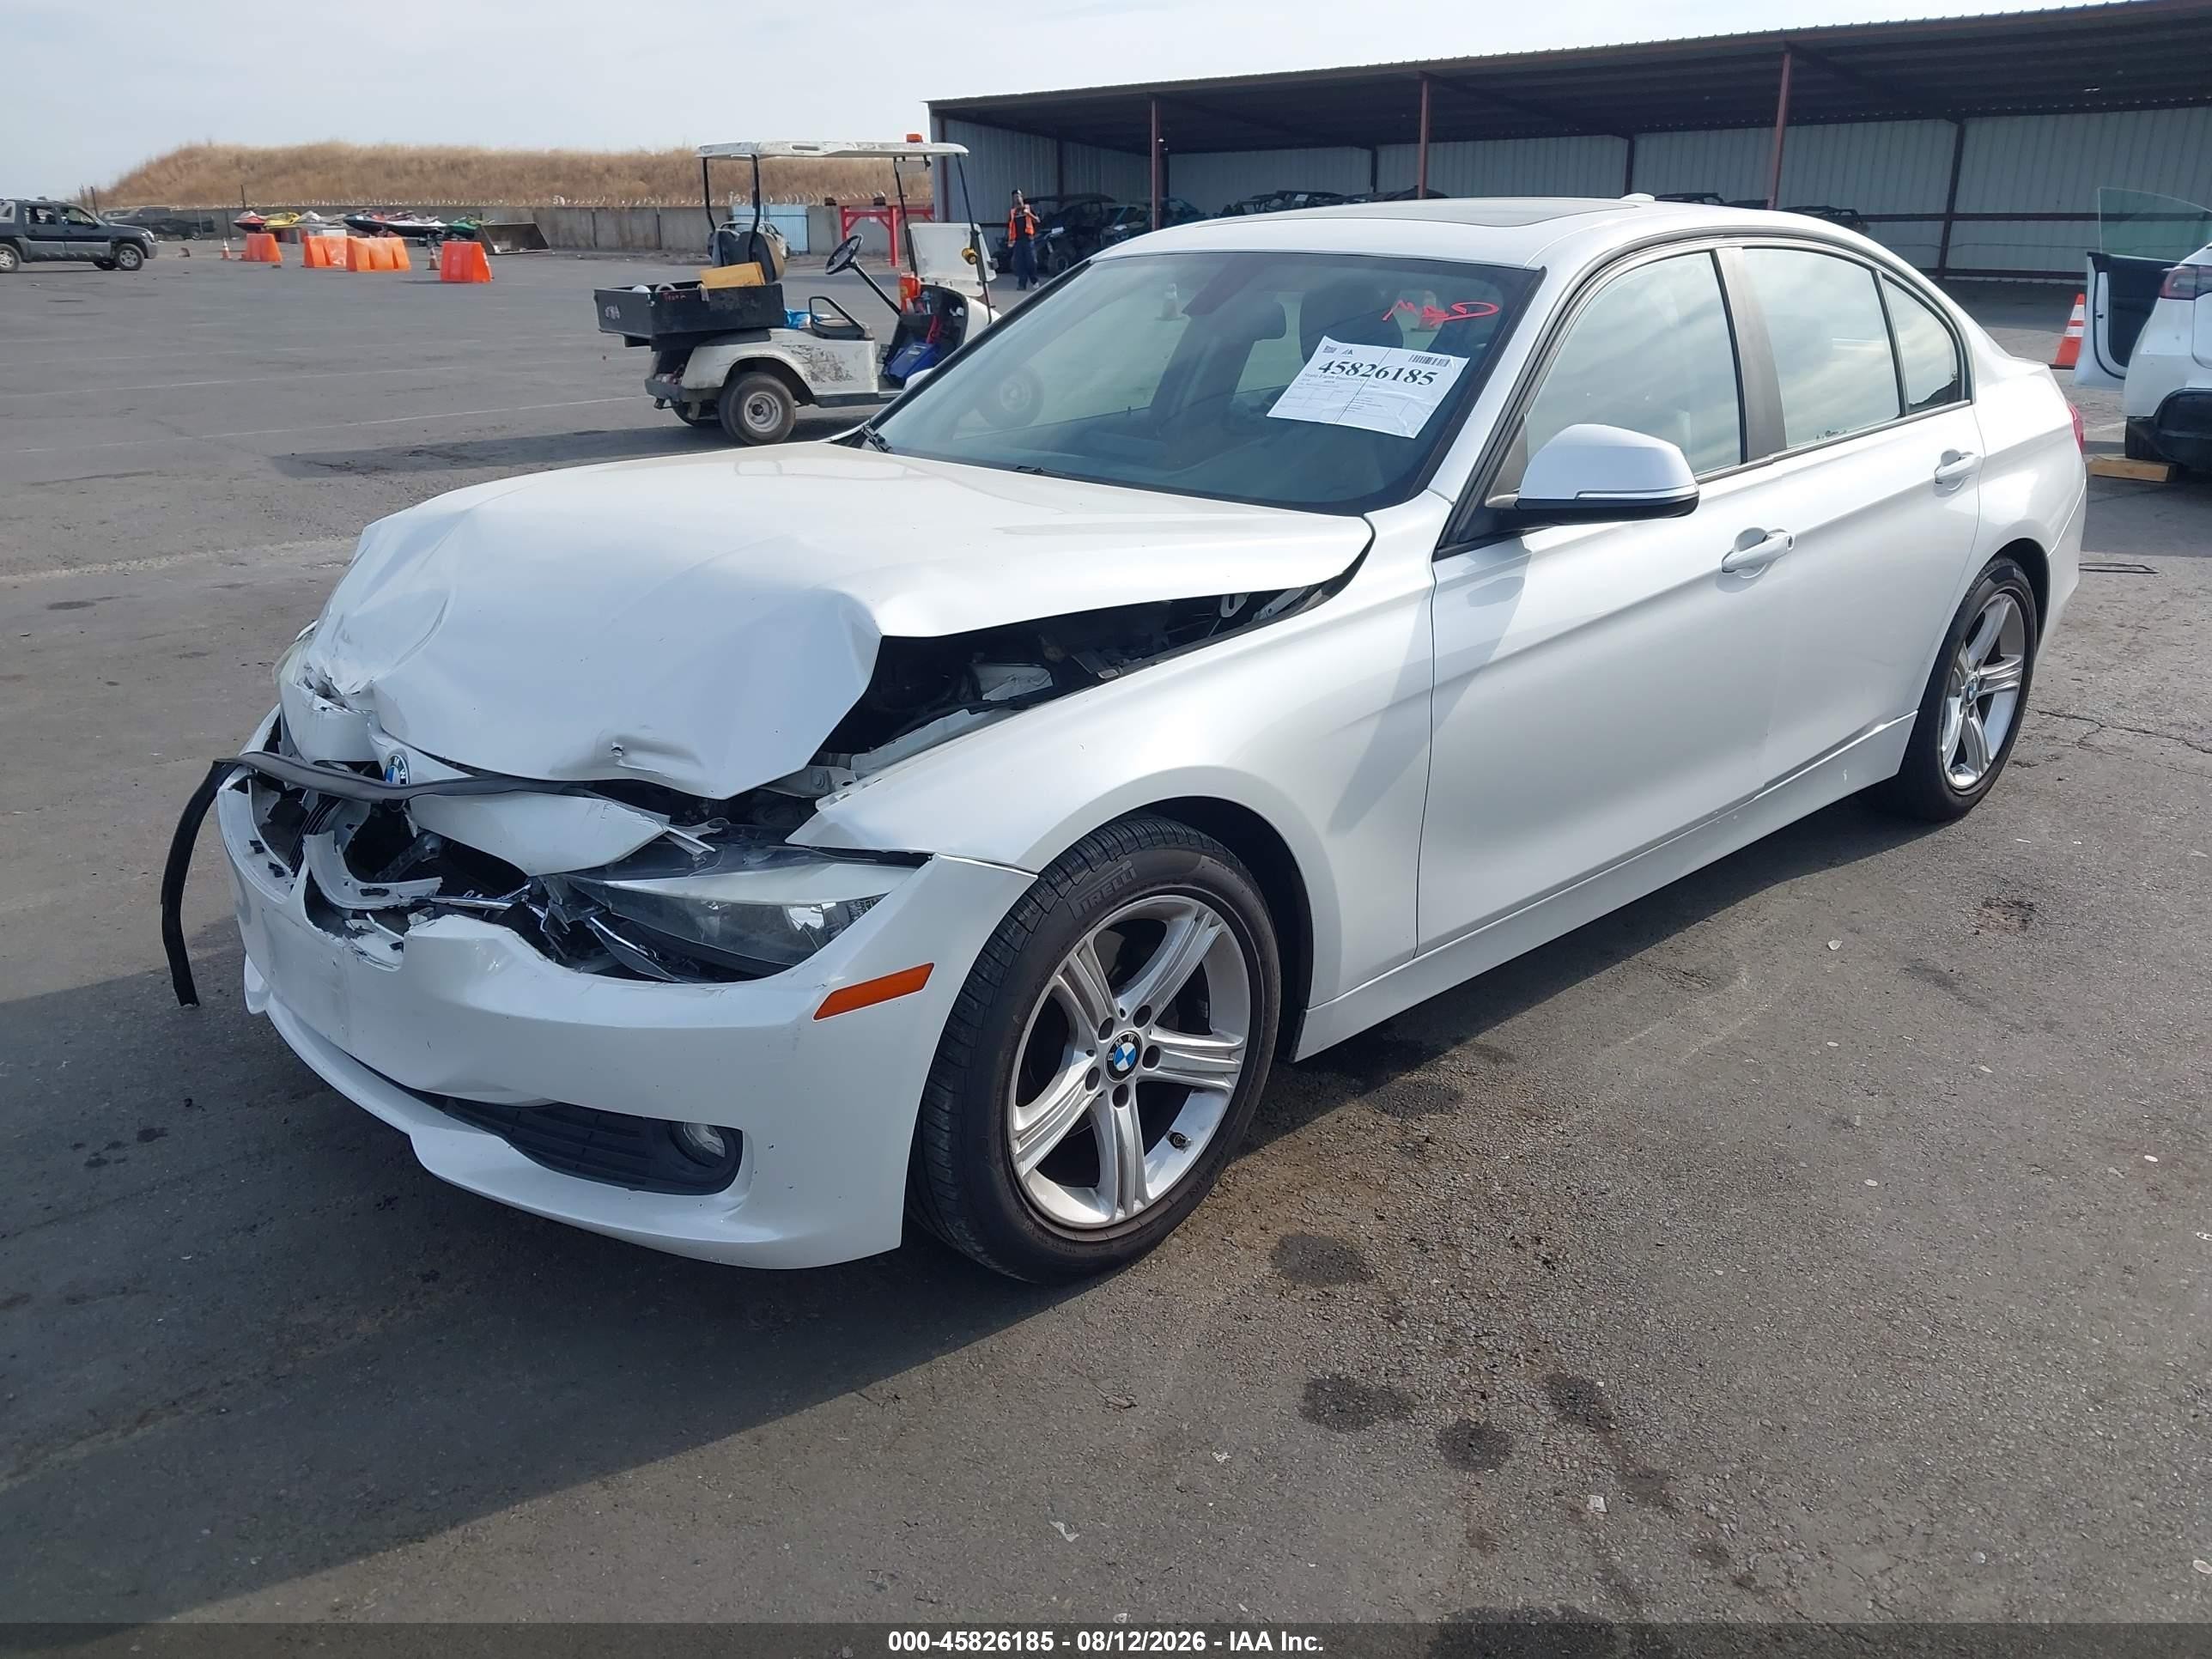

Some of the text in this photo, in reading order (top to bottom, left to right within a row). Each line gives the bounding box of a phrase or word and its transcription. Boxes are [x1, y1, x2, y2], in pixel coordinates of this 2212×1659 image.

[1318, 359, 1438, 387] 45826185
[1066, 860, 1138, 921] PIRELLI
[1107, 1033, 1135, 1061] BMW
